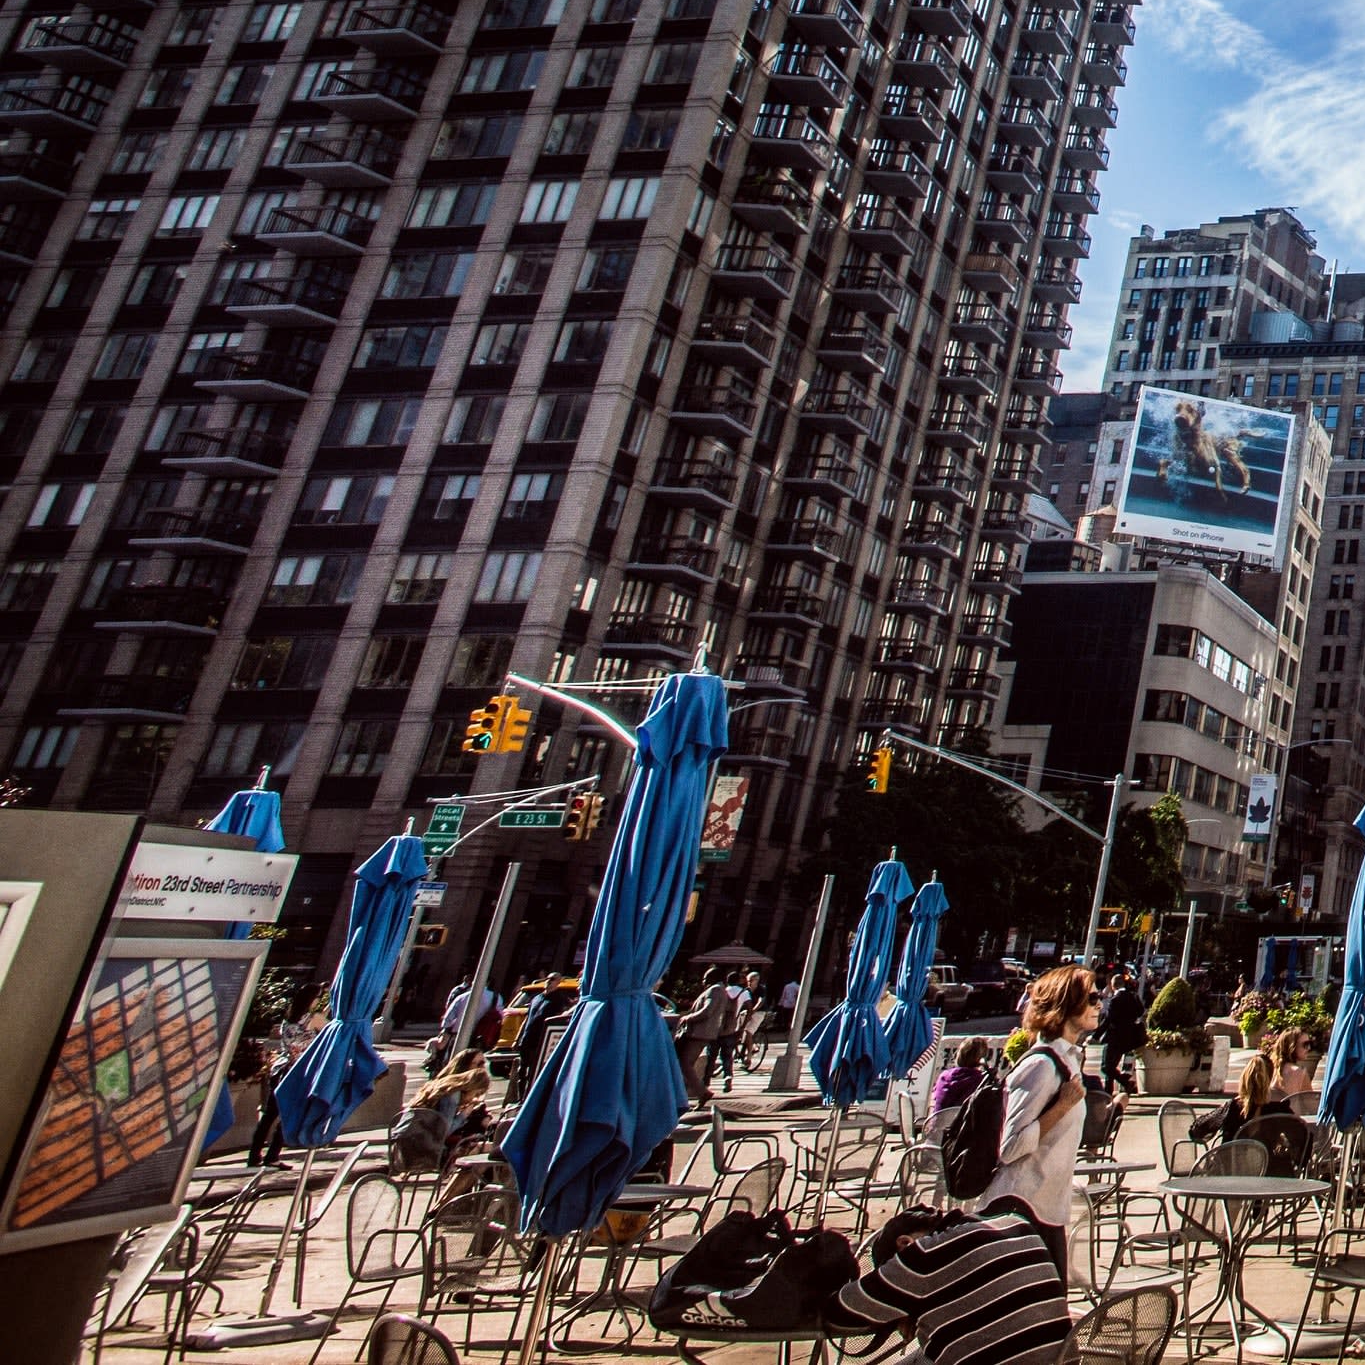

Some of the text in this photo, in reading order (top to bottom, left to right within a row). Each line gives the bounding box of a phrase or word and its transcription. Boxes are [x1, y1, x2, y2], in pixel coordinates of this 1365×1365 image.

[1172, 527, 1189, 538] Shot
[1189, 531, 1200, 539] on
[1200, 531, 1225, 543] iPhone
[515, 815, 546, 825] E 23 St
[162, 875, 191, 892] 23rd
[190, 878, 225, 894] Street
[225, 878, 283, 901] Partnership
[681, 1313, 748, 1327] adidas
